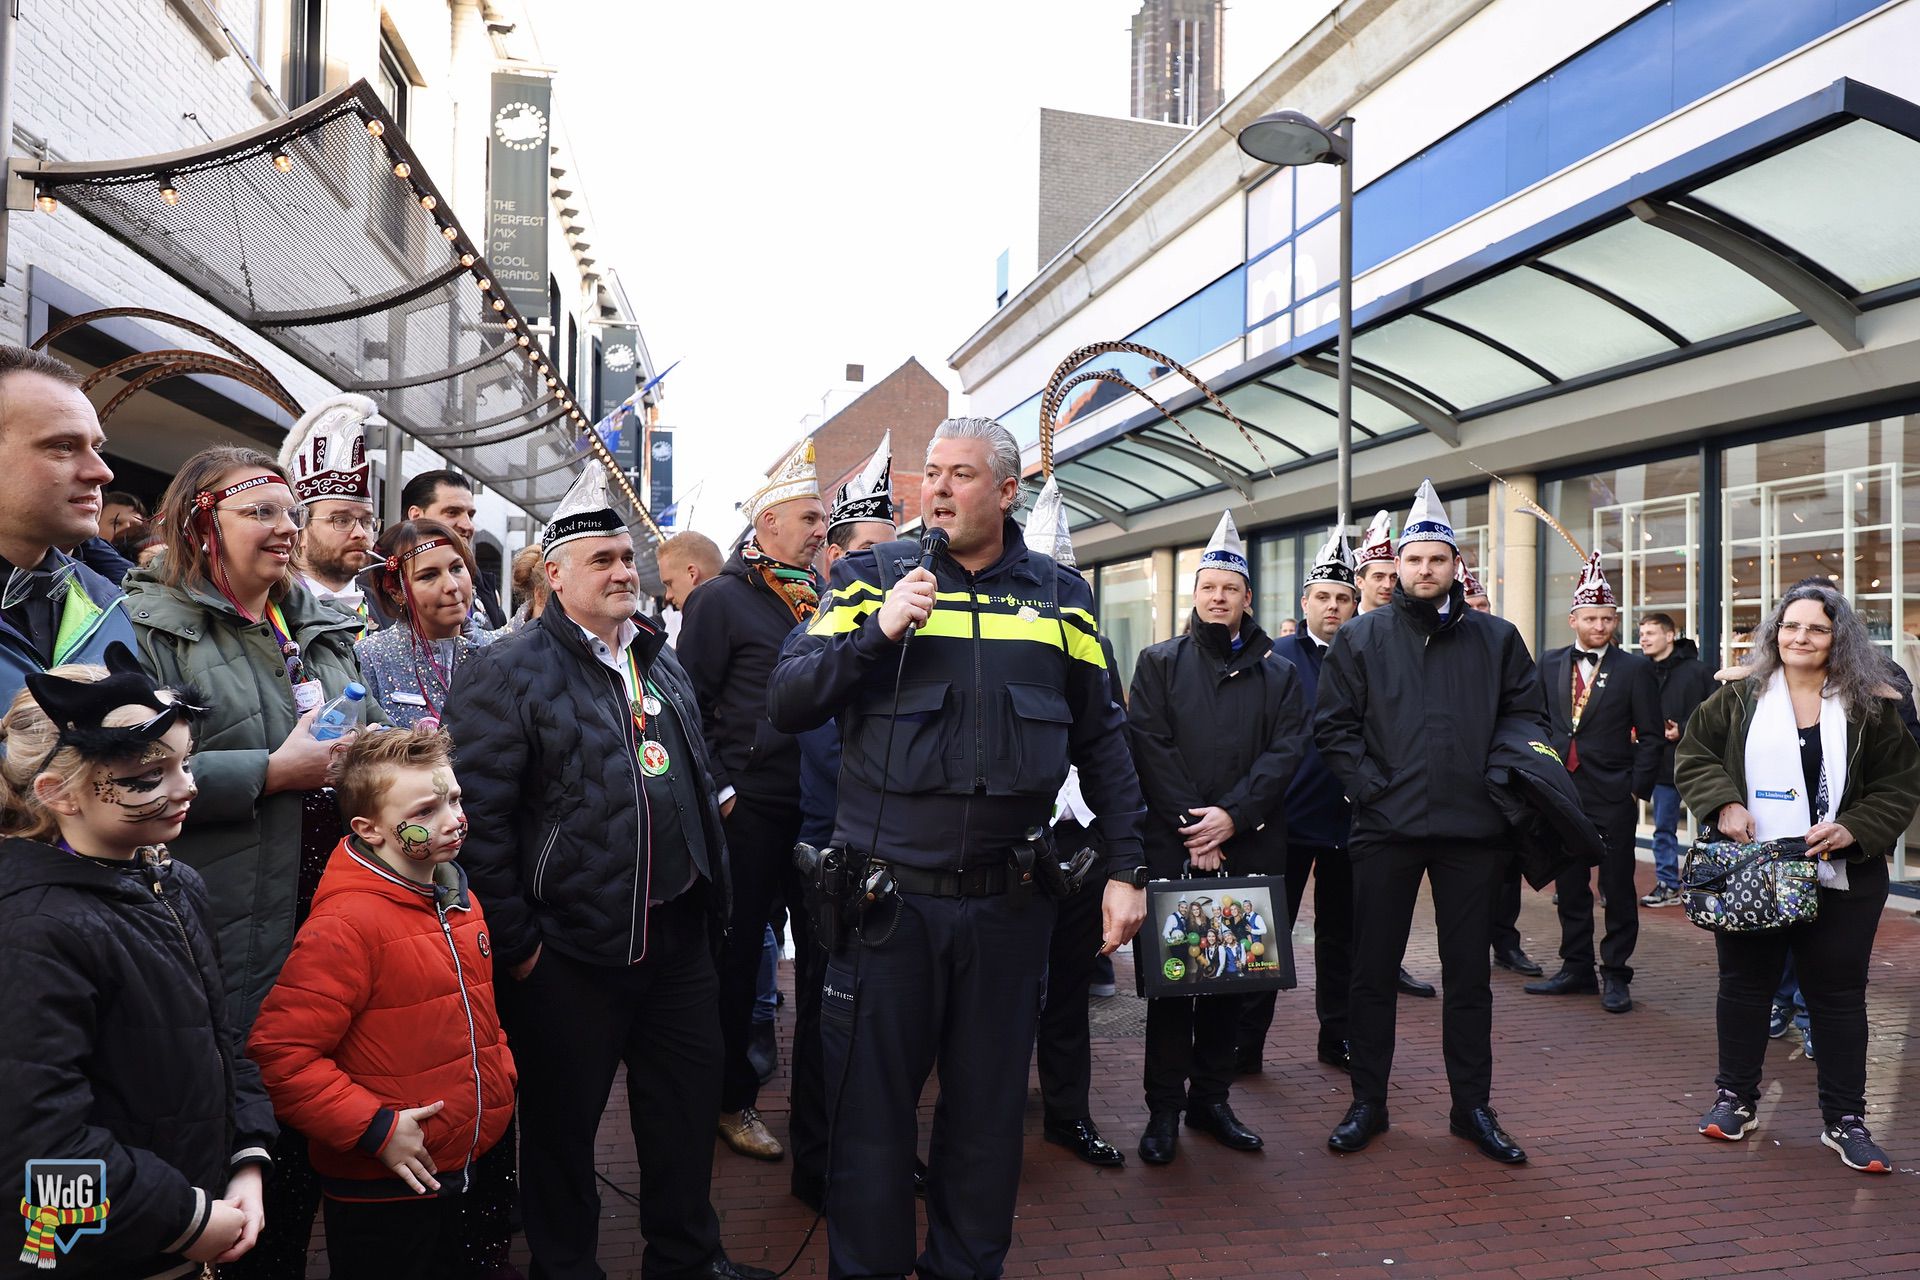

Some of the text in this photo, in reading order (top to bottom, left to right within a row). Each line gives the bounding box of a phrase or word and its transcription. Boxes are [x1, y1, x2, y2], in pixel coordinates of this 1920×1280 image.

[493, 200, 516, 211] THE
[493, 214, 545, 227] PERFECT
[493, 228, 517, 238] MIX
[493, 242, 511, 252] OF
[493, 256, 529, 267] COOL
[494, 269, 540, 281] BRANDS
[225, 477, 269, 496] ADJUDANT
[578, 520, 602, 529] Prins
[1000, 593, 1043, 608] POLITIE
[823, 984, 847, 999] POLITIE
